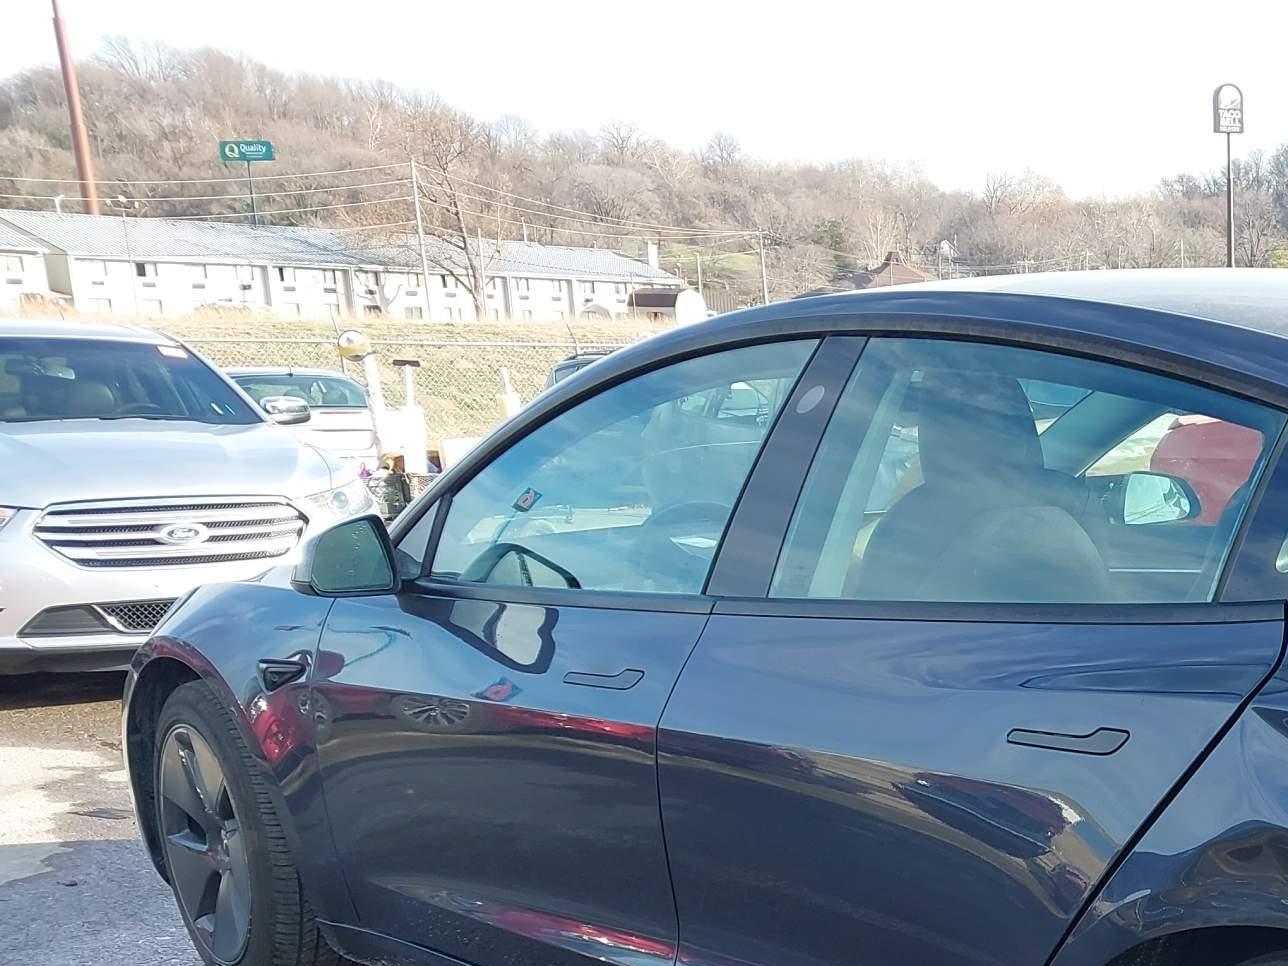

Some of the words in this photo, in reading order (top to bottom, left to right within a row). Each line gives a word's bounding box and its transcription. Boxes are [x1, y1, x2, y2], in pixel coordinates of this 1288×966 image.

[1218, 109, 1241, 119] TACO
[240, 144, 266, 153] Quality
[172, 528, 195, 538] Ford
